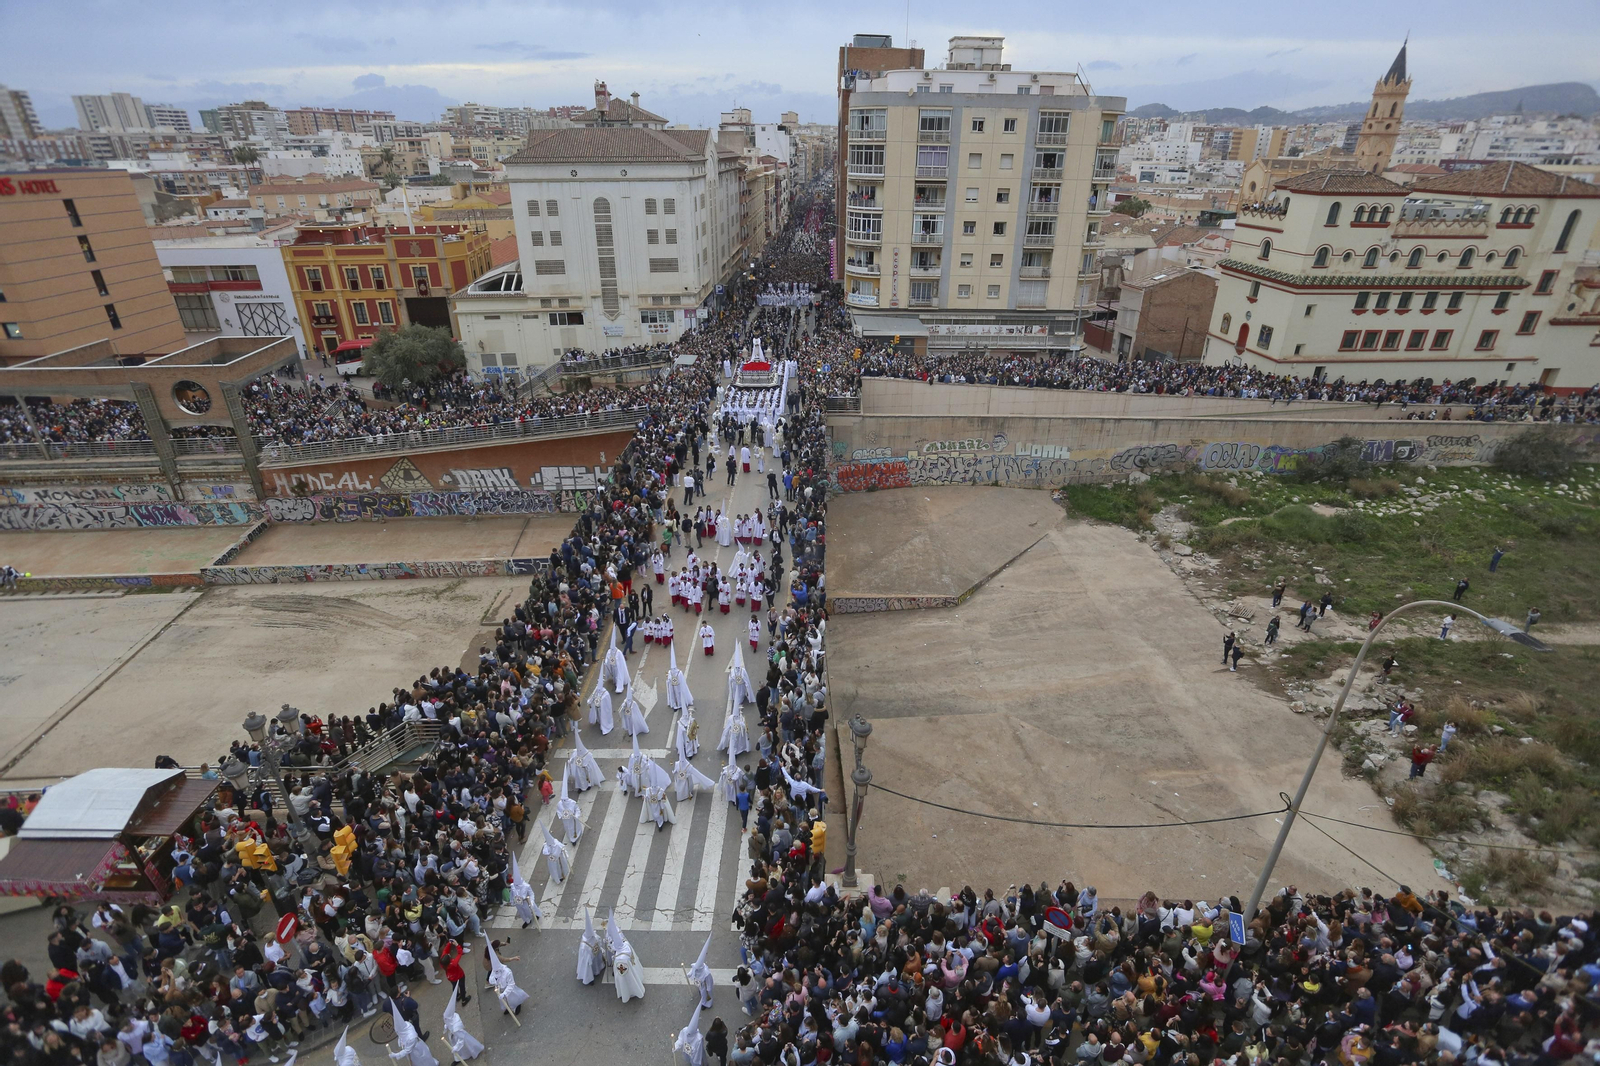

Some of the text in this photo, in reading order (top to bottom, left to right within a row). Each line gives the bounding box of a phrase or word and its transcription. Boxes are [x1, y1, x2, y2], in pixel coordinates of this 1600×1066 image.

[18, 179, 62, 194] HOTEL
[715, 284, 723, 292] P
[36, 488, 120, 503] MONCAL
